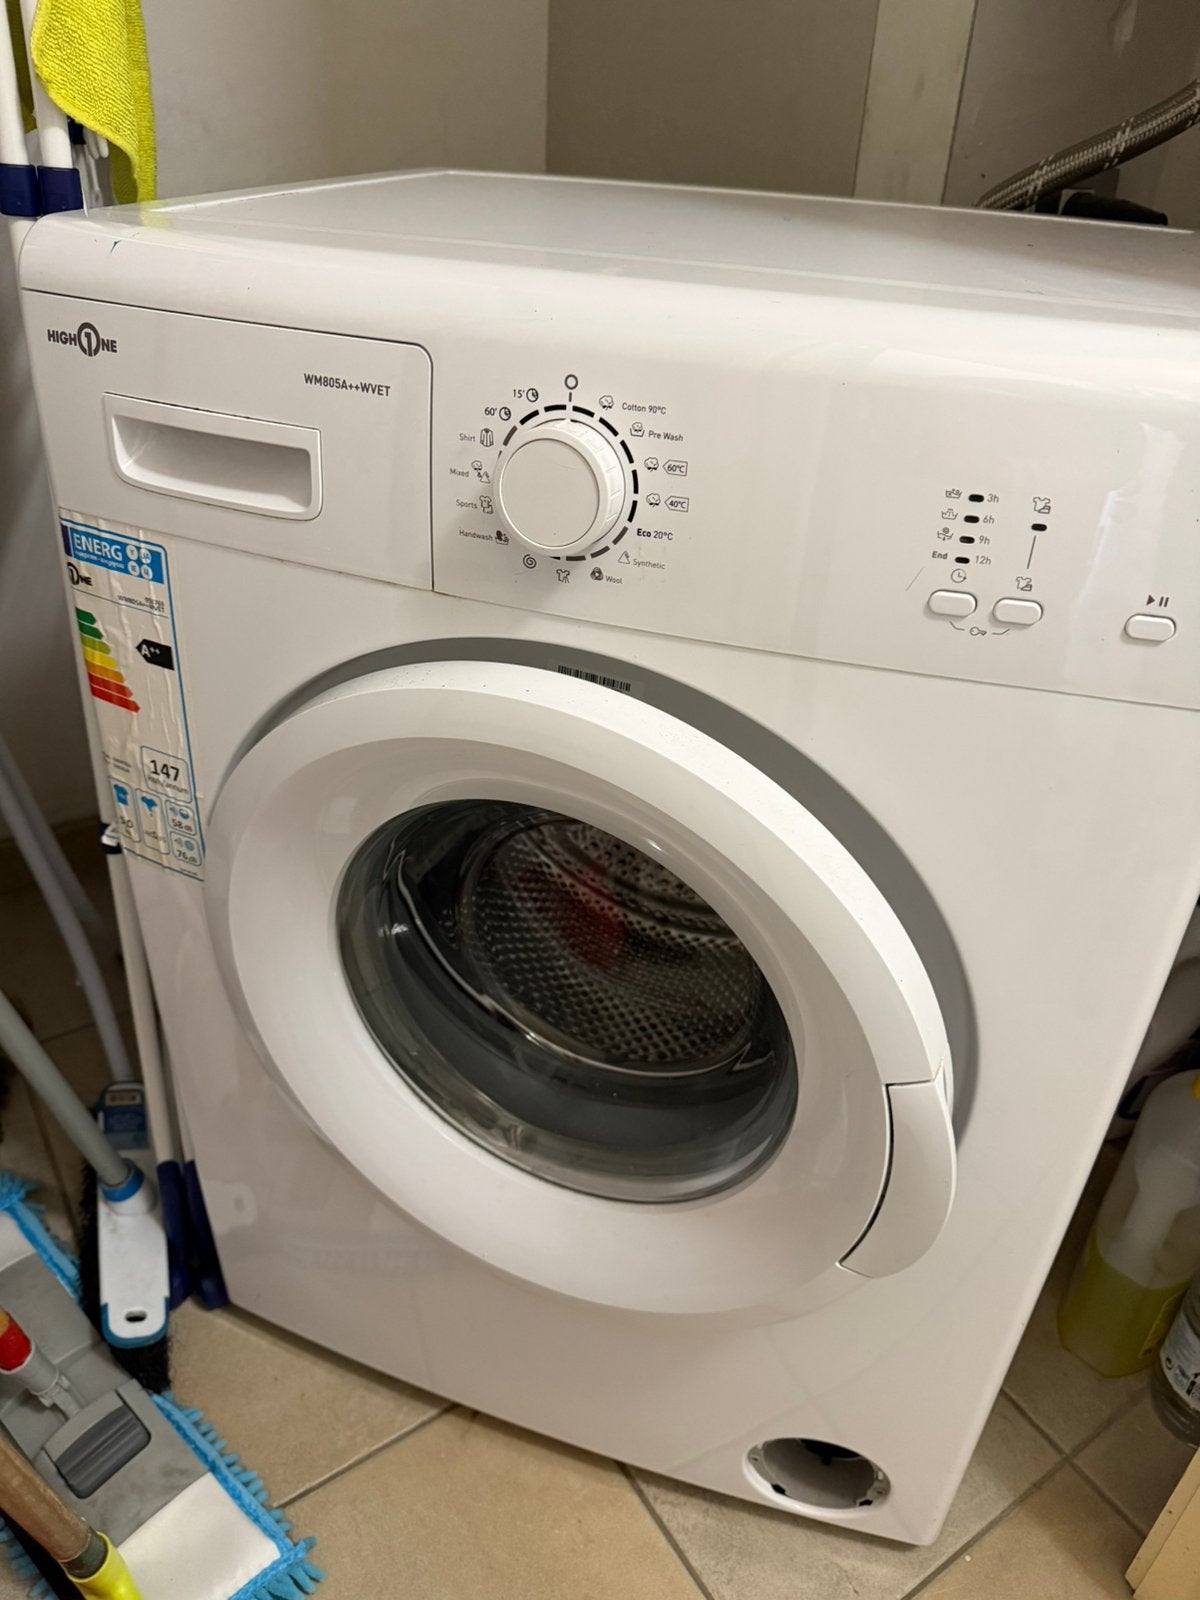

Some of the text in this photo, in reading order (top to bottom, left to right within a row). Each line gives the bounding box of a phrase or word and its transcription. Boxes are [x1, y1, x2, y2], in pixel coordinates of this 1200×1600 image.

[303, 373, 391, 397] WM805A++WVET
[621, 402, 646, 413] Cotton
[459, 433, 476, 443] Shirt
[648, 430, 684, 442] Pre Wash
[449, 467, 470, 478] Mixed
[667, 462, 685, 474] 60°C
[668, 498, 686, 509] 40°C
[987, 493, 999, 503] 3h
[455, 499, 478, 510] Sports
[982, 515, 994, 524] 6h
[458, 529, 494, 542] Handwash
[636, 528, 652, 539] Eco
[978, 536, 990, 545] 9h
[73, 533, 123, 562] ENERG
[931, 551, 948, 560] End
[975, 555, 991, 565] 12h
[632, 557, 667, 570] Synthetic
[605, 575, 624, 586] Wool
[140, 644, 161, 658] A++
[150, 759, 180, 782] 147
